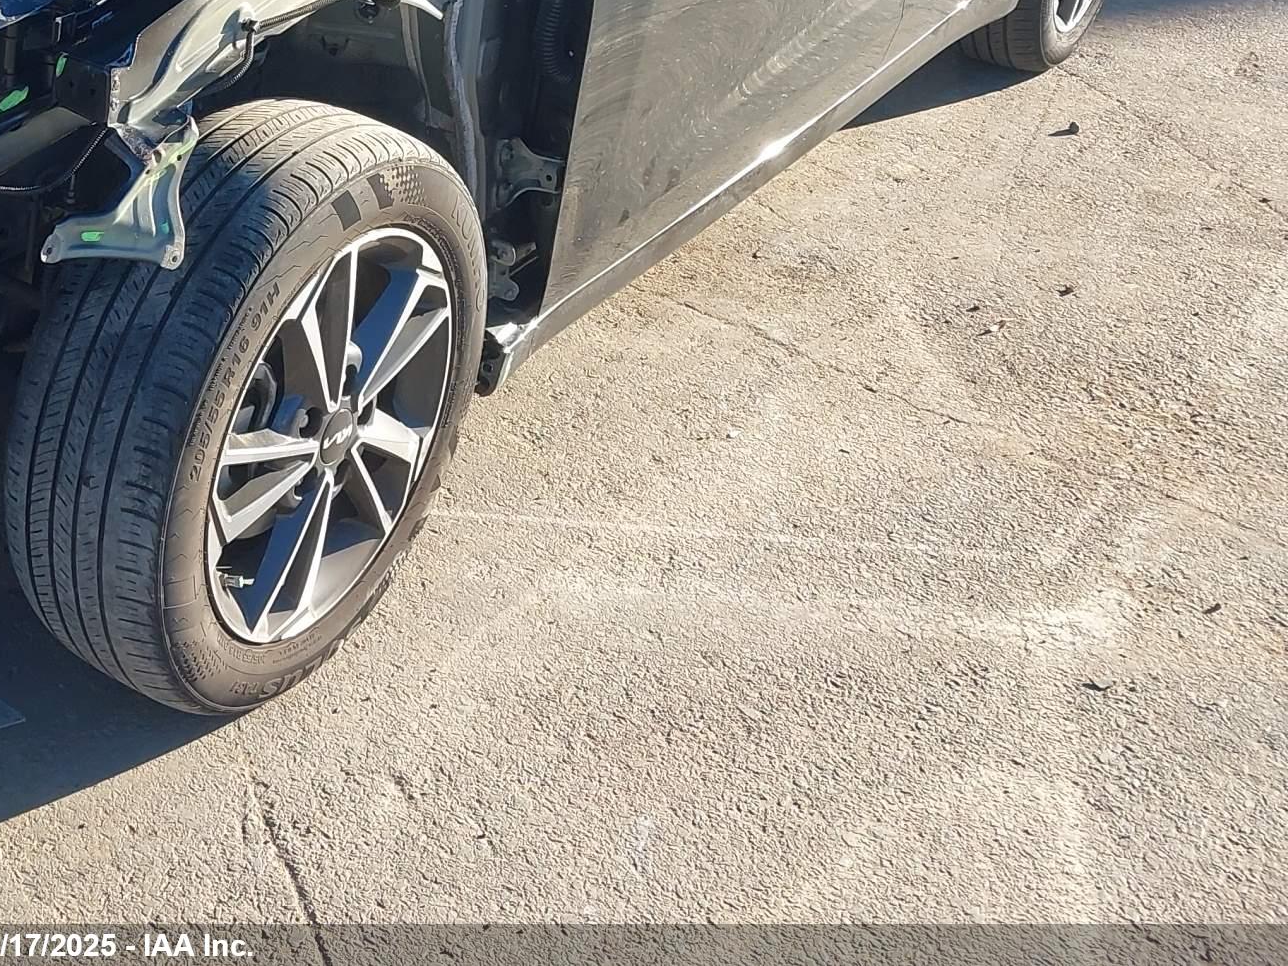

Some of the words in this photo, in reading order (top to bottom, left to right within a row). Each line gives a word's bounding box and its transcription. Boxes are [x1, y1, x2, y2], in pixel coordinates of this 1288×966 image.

[190, 390, 225, 483] 205/55
[224, 335, 251, 387] R16
[250, 282, 281, 332] 91H
